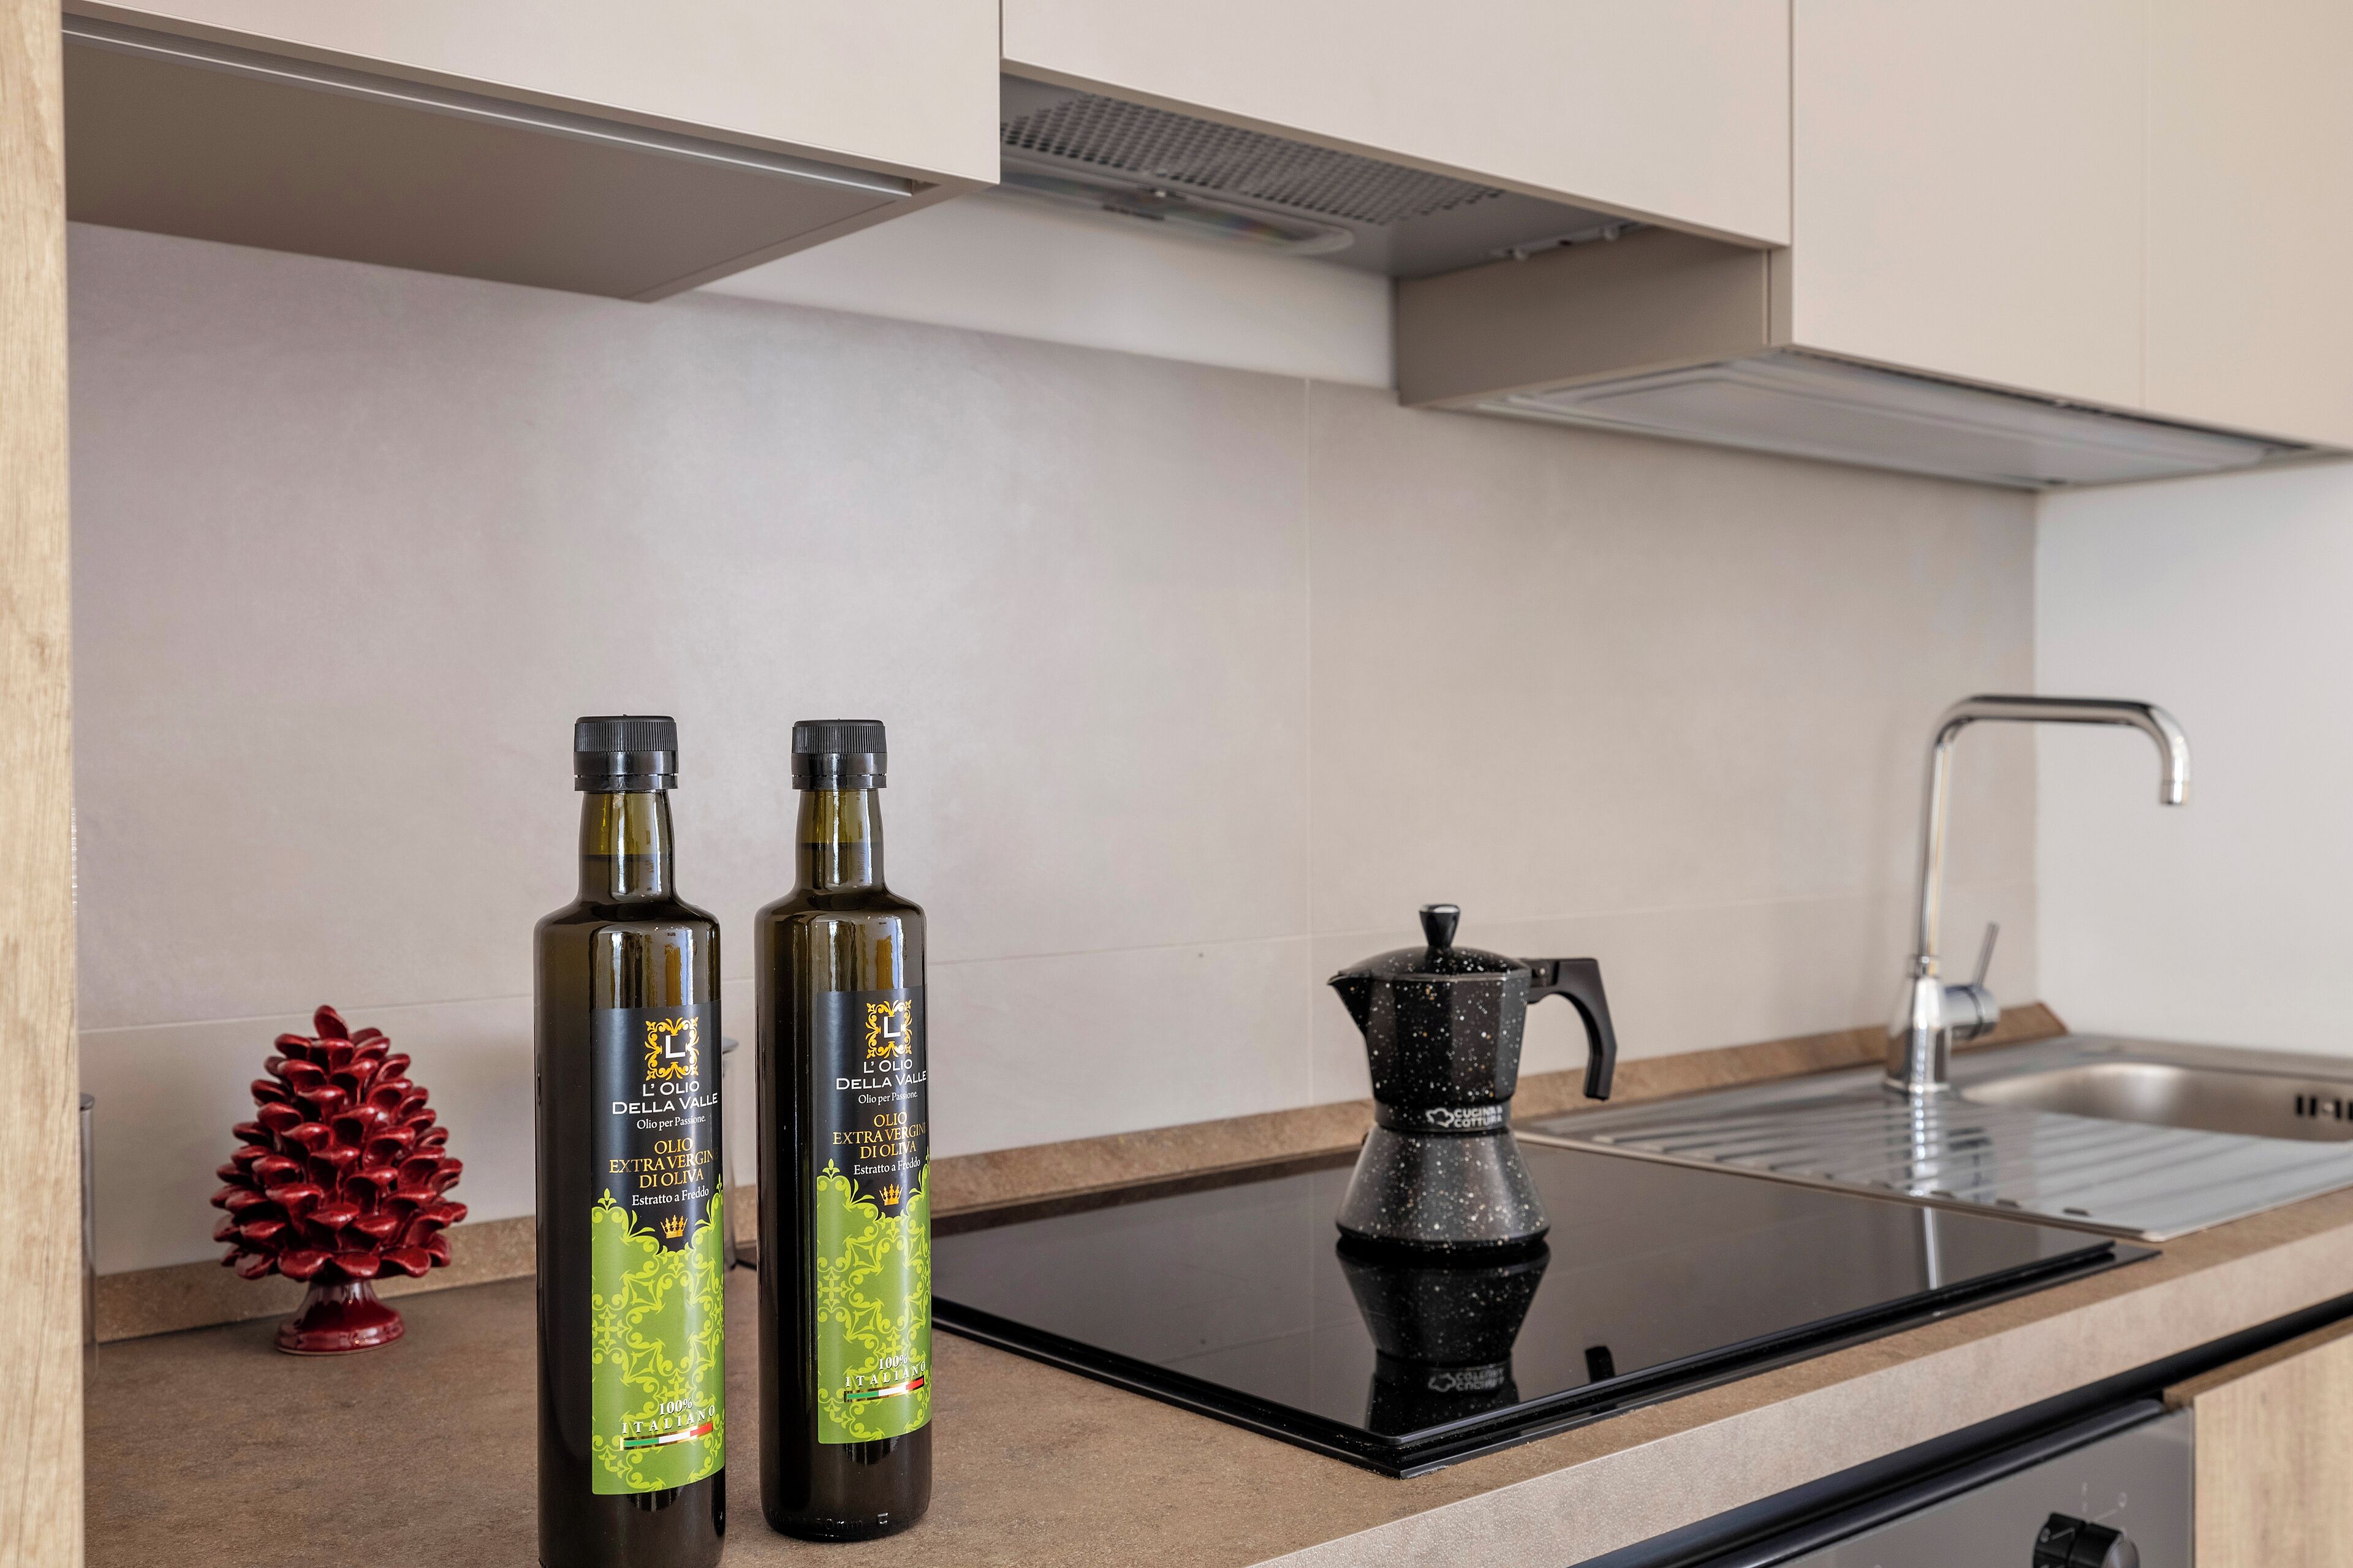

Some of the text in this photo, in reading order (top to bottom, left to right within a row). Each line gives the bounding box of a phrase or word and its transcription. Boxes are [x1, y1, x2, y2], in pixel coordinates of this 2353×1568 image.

[884, 1017, 901, 1038] L
[665, 1035, 685, 1059] L
[836, 1070, 926, 1090] DELLA VALLE
[613, 1093, 718, 1115] DELLA VALLE
[858, 1091, 918, 1105] Olio per Passione.
[637, 1115, 706, 1131] Olio per Passione.
[874, 1112, 907, 1127] OLIO
[833, 1123, 926, 1145] EXTRA VERGIN
[654, 1137, 693, 1154] OLIO
[860, 1139, 916, 1159] DI OLIVA
[609, 1147, 718, 1173] EXTRA VERGIN
[854, 1162, 890, 1175] Estratto
[898, 1157, 920, 1171] Freddo
[639, 1168, 704, 1188] DI OLIVA
[632, 1192, 673, 1206] Estratto
[681, 1186, 709, 1201] Freddo
[879, 1354, 907, 1371] 100%
[846, 1361, 926, 1387] ITALIANO
[660, 1398, 692, 1416] 100%
[623, 1405, 715, 1434] ITALIANO
